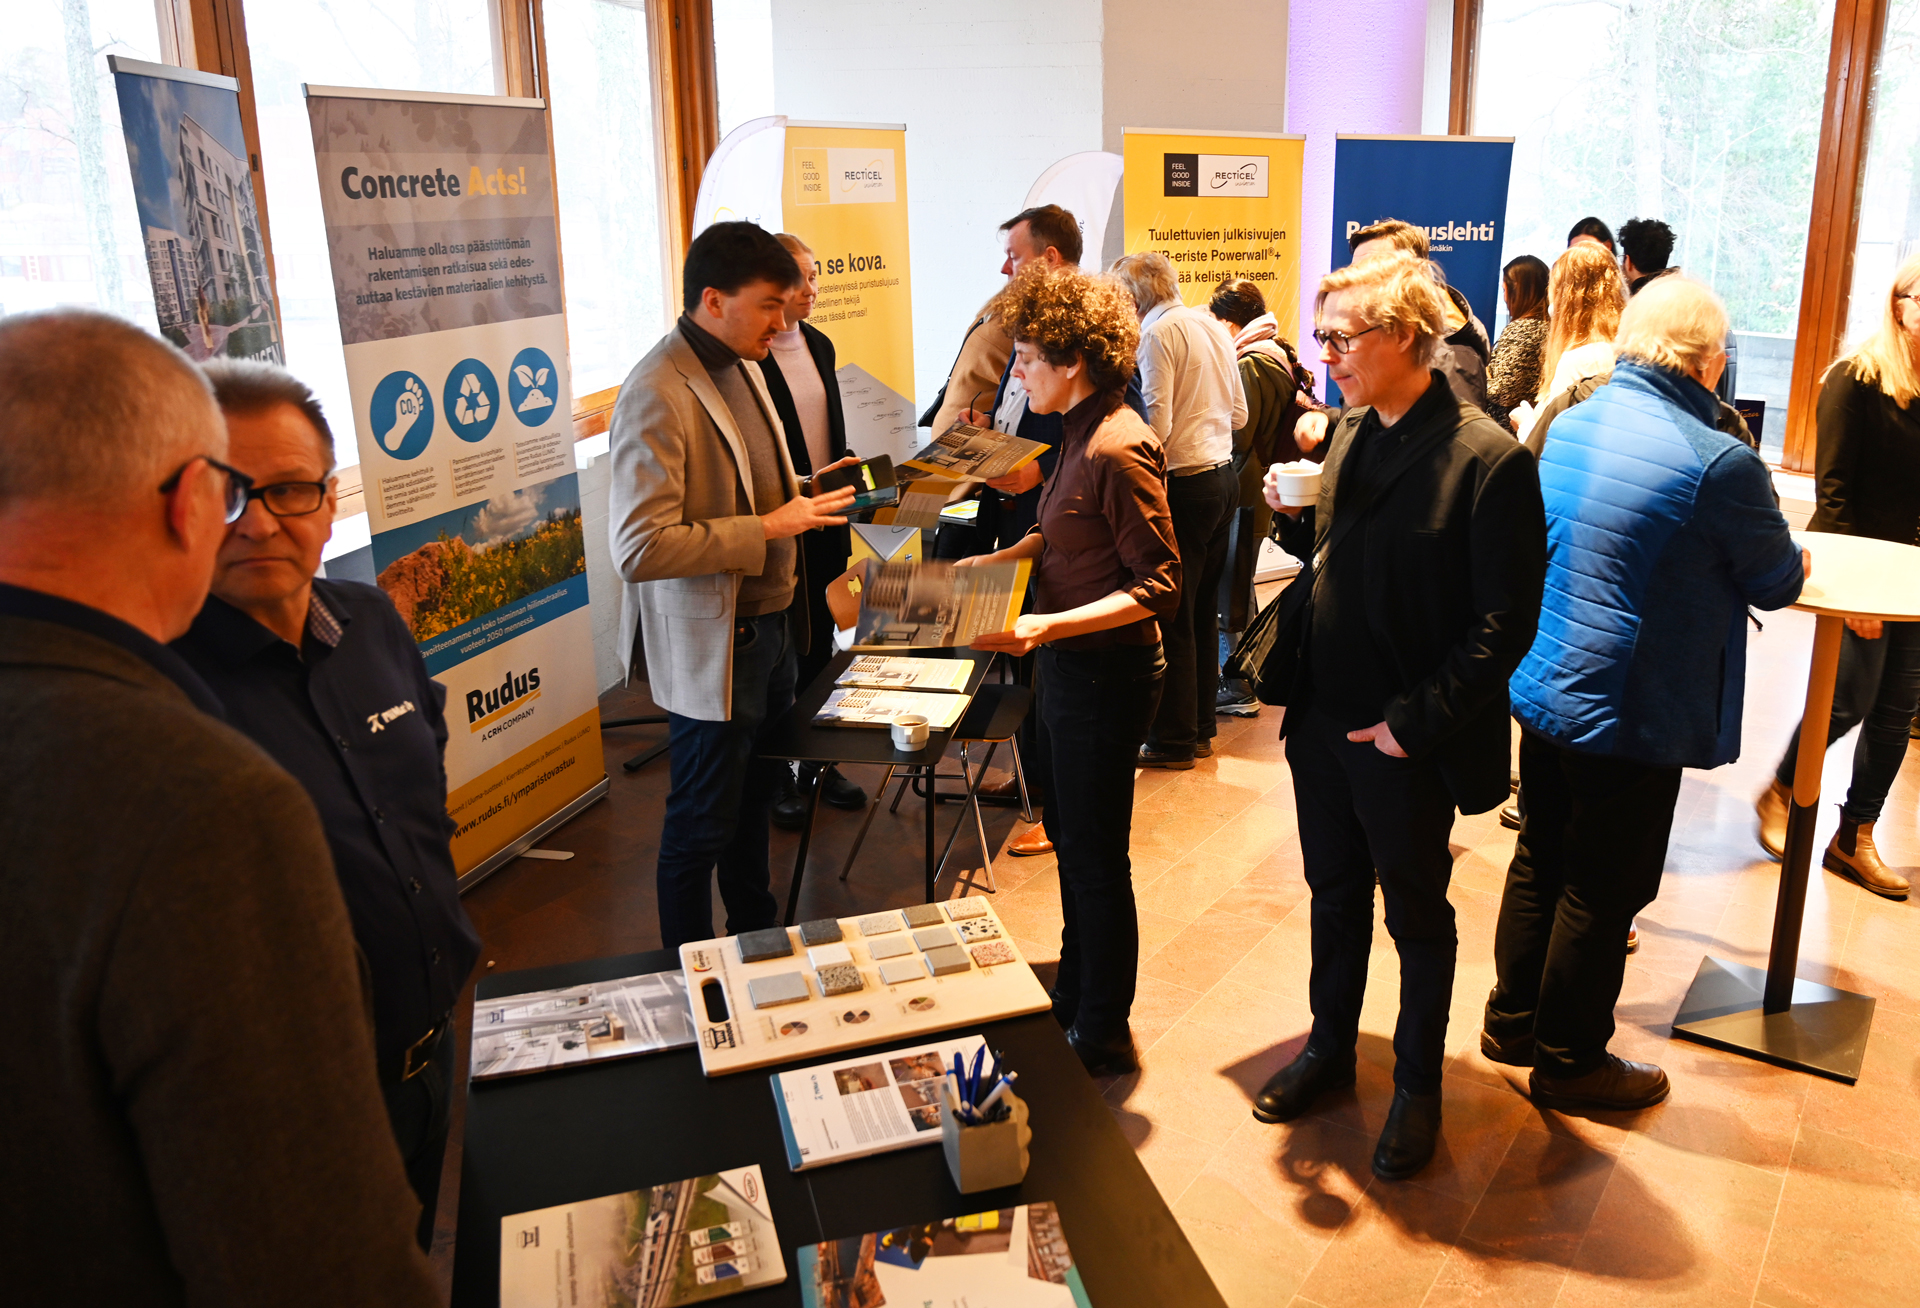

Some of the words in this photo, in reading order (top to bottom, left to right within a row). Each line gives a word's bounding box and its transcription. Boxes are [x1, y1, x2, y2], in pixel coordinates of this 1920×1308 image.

[802, 161, 815, 169] FEEL
[341, 167, 460, 199] Concrete
[468, 166, 527, 196] Acts!
[1149, 229, 1220, 241] Tuulettuvien
[1223, 228, 1286, 243] julkisivujen
[368, 244, 426, 260] Haluamme
[428, 241, 447, 256] olla
[449, 243, 465, 255] osa
[467, 238, 530, 255] päästöttömän
[368, 263, 440, 282] rakentamisen
[443, 259, 487, 274] ratkaisua
[489, 258, 508, 271] sekä
[510, 258, 534, 269] edes-
[827, 258, 844, 275] se
[849, 253, 886, 272] kova.
[859, 277, 899, 291] puristuslujuus
[1195, 270, 1231, 282] kelistä
[356, 291, 393, 305] auttaa
[395, 285, 444, 301] kestävien
[446, 277, 504, 296] materiaalien
[505, 273, 547, 291] kehitystä.
[844, 295, 860, 306] tekijä
[829, 311, 846, 321] tässä
[847, 308, 867, 318] omasi!
[382, 473, 410, 483] Haluamme
[473, 627, 481, 636] on
[482, 619, 496, 632] koko
[497, 606, 527, 624] toiminnan
[460, 638, 486, 654] vuoteen
[487, 628, 503, 643] 2050
[504, 615, 535, 634] mennessä.
[466, 667, 541, 723] Rudus
[482, 734, 487, 742] A
[488, 724, 503, 739] CRH
[503, 707, 535, 730] COMPANY
[540, 754, 545, 763] ja
[564, 735, 577, 746] Rudus
[454, 756, 575, 840] www.rudus.fi/ymparistovastuu
